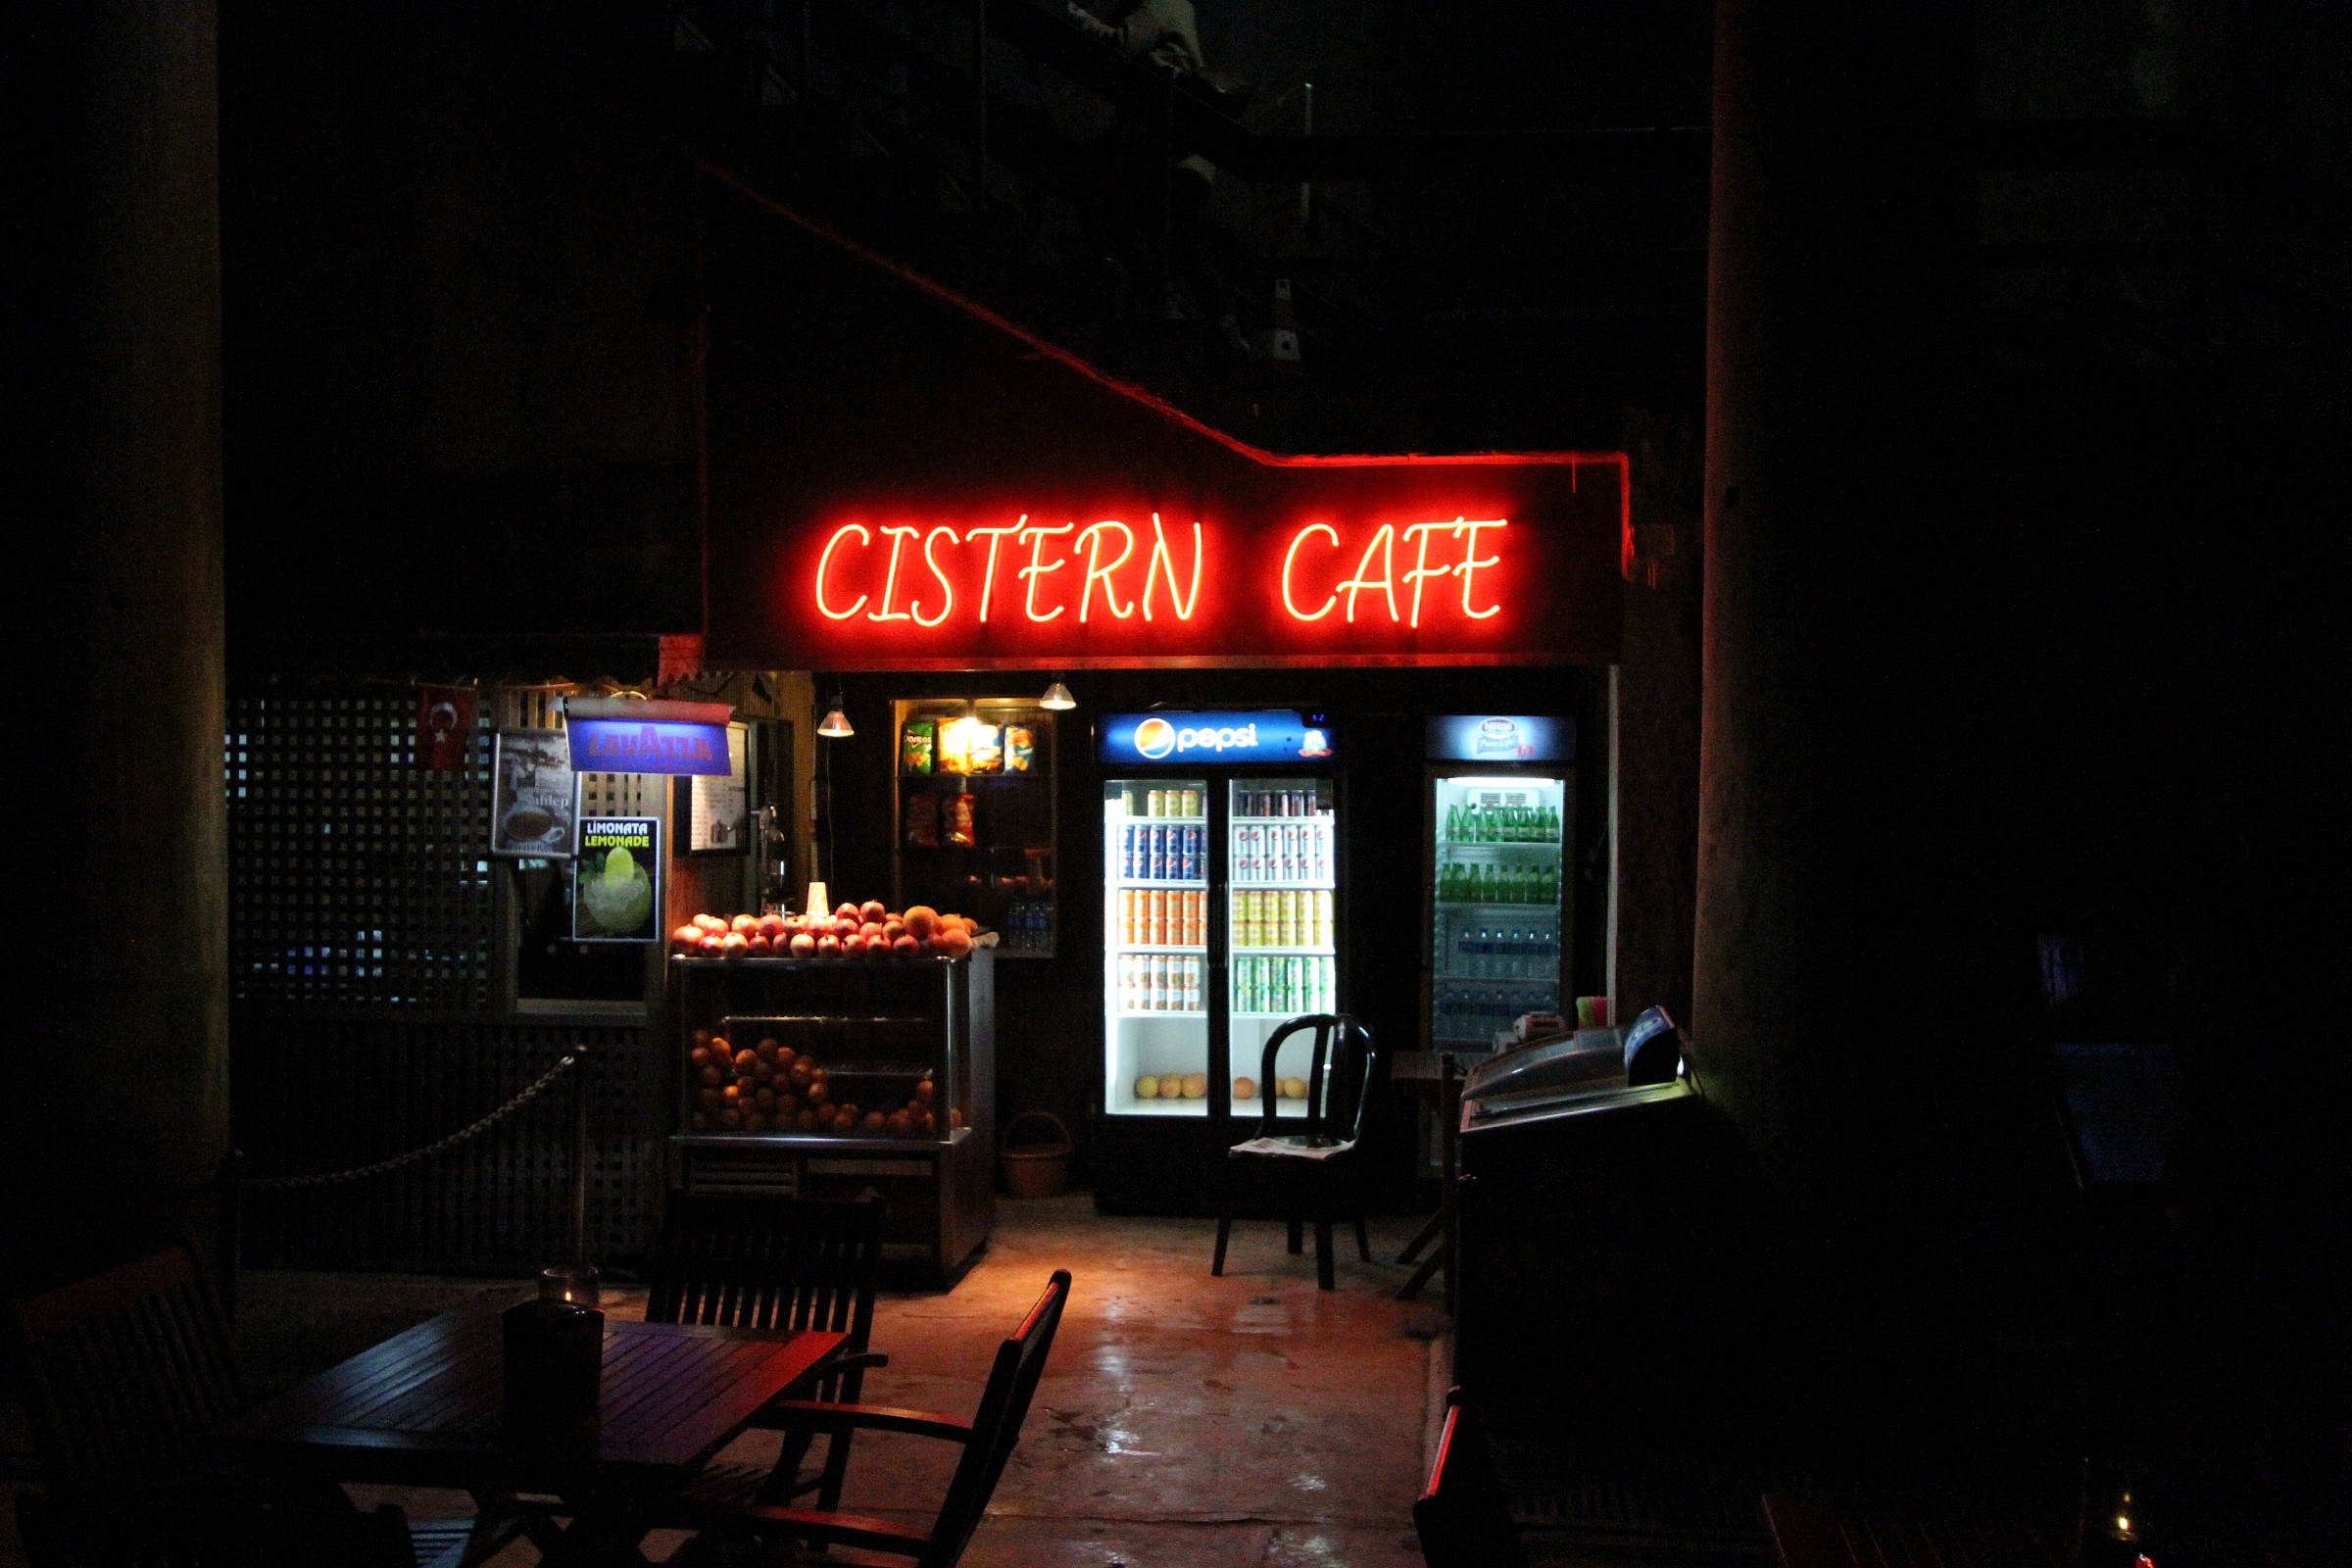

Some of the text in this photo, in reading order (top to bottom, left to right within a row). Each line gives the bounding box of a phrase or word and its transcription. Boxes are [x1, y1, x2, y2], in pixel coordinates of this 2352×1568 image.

[815, 513, 1508, 627] CISTERN CAFE
[589, 725, 712, 761] LAVAZZA
[1177, 722, 1256, 753] pepsi
[584, 835, 650, 848] LEMONADE
